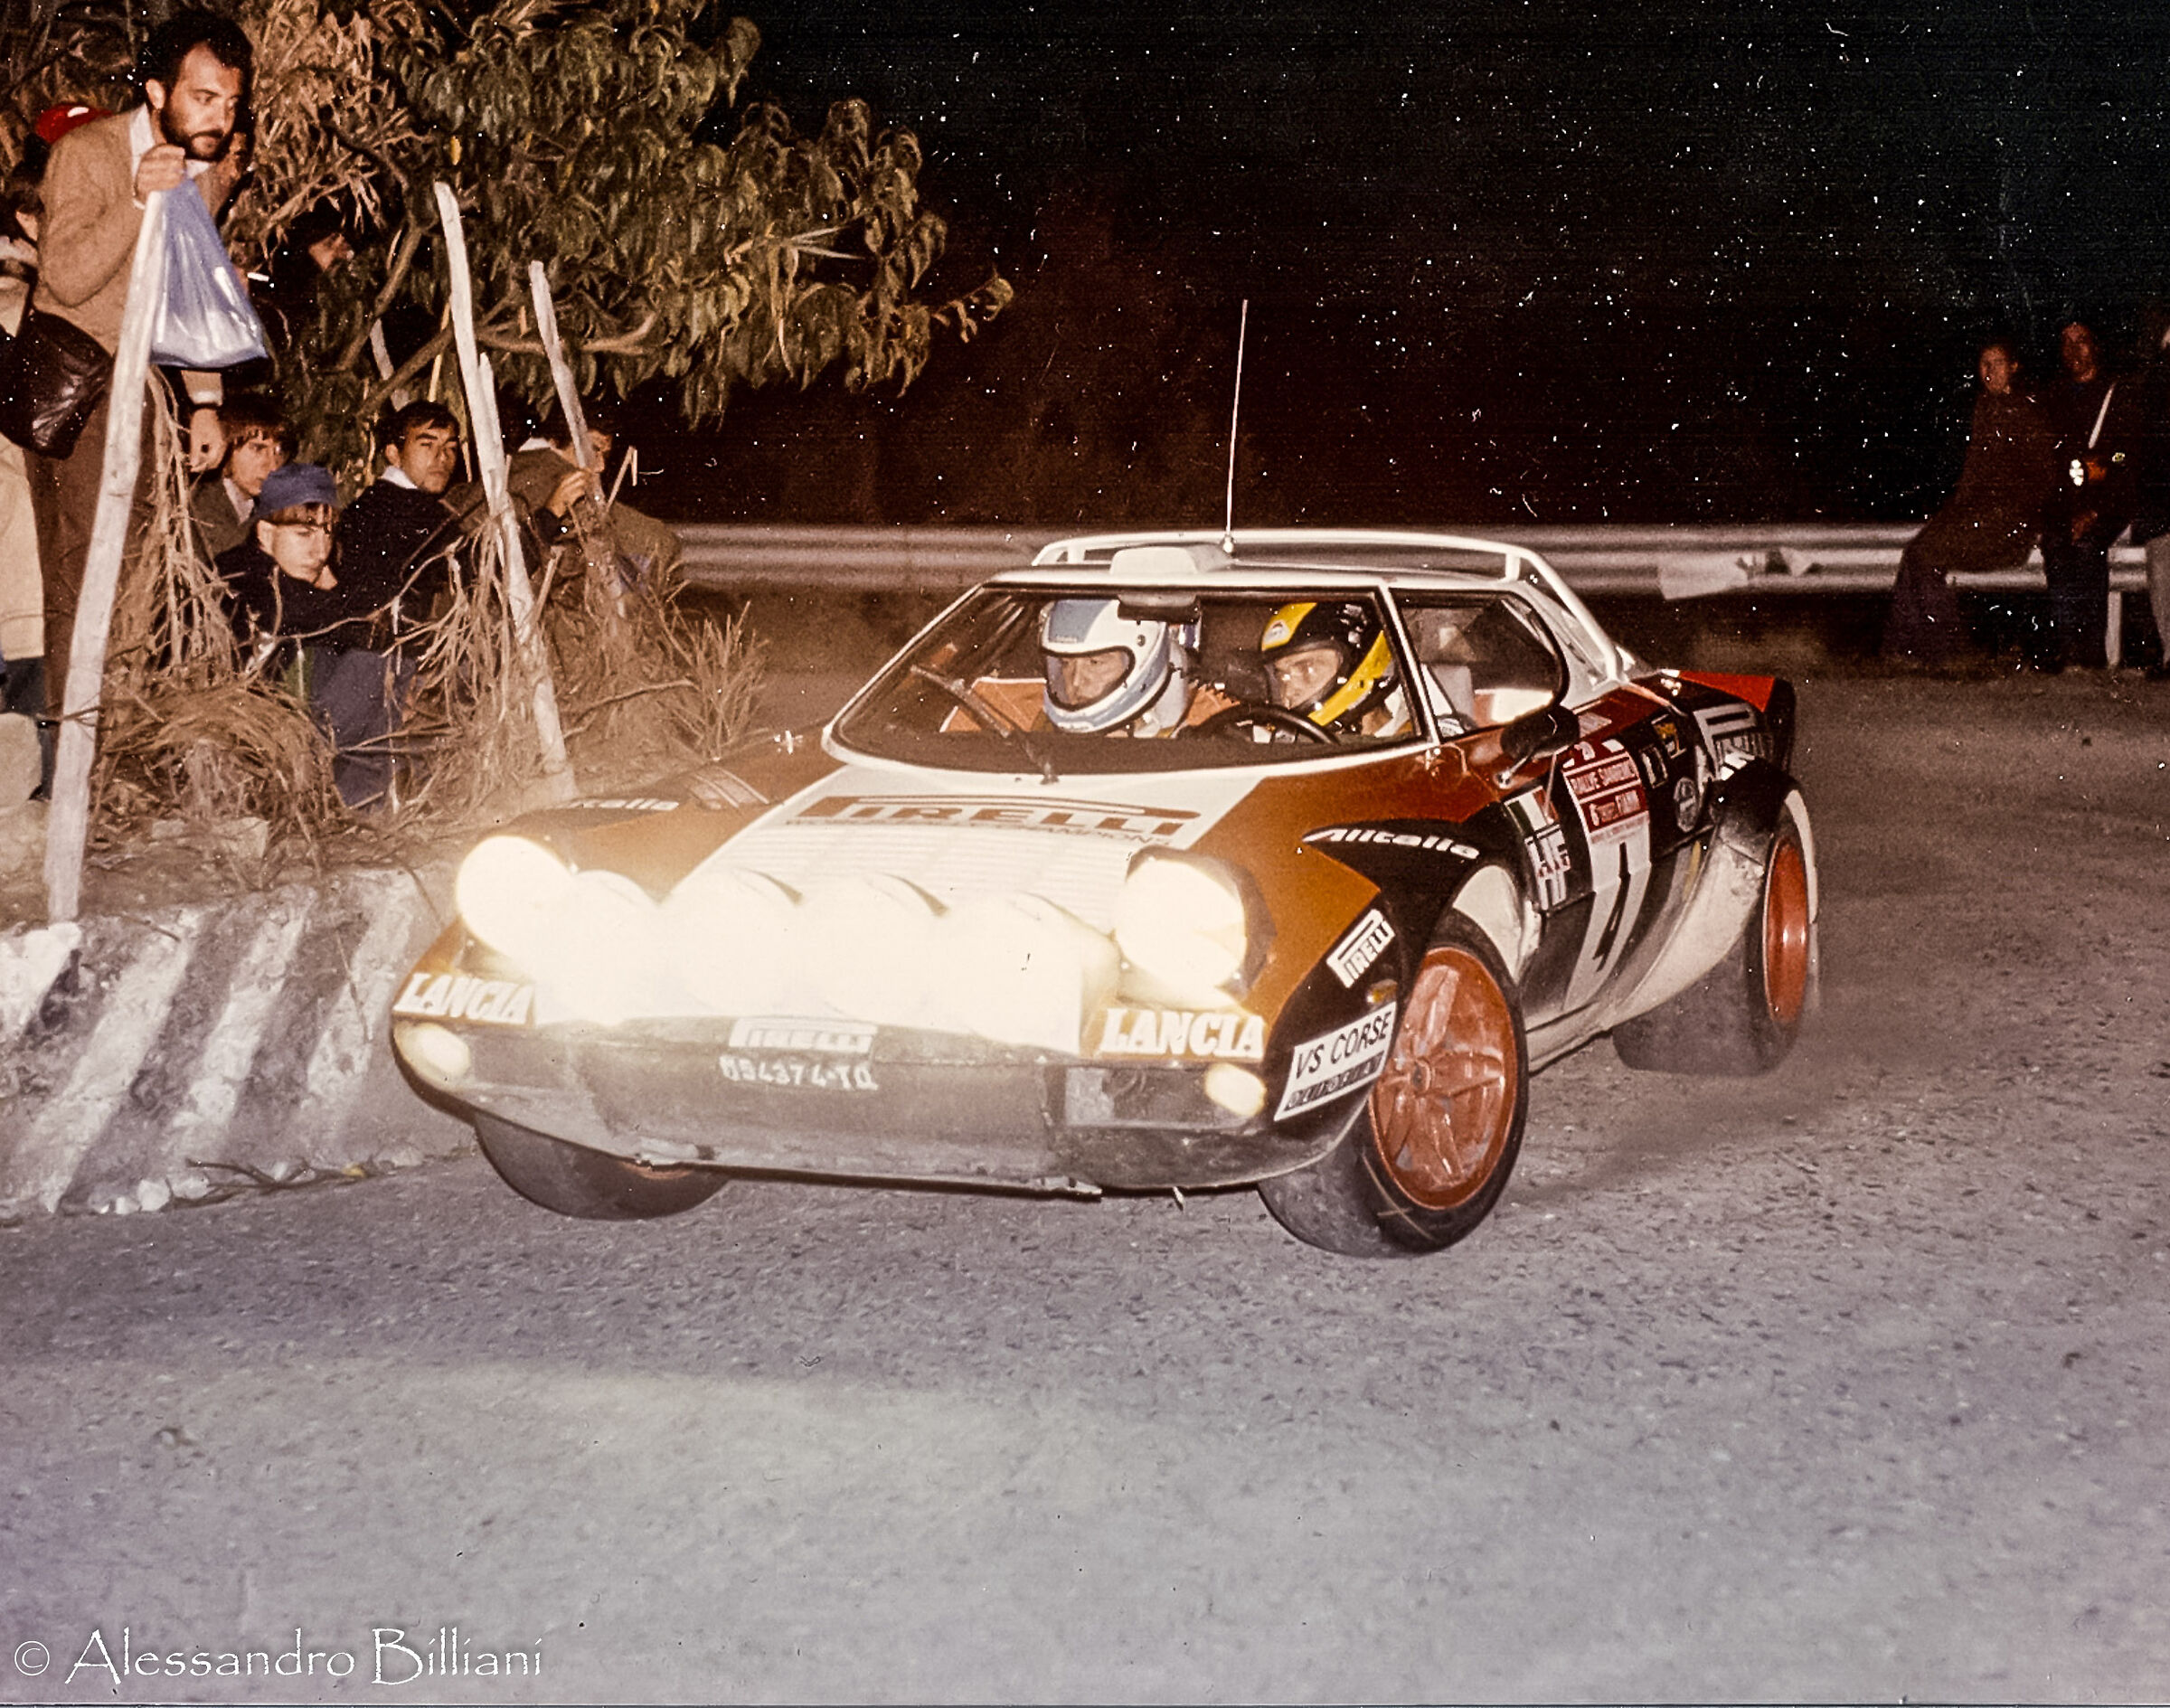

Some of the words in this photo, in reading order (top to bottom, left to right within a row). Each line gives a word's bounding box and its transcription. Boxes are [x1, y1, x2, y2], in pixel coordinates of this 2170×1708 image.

[795, 795, 1201, 836] PIRELLI
[1302, 828, 1480, 859] Alitalia
[1326, 909, 1396, 988] PIRELLI
[392, 972, 534, 1024] LANCIA
[729, 1015, 878, 1054] PIRELLI
[1099, 1007, 1266, 1059] LANCIA
[1296, 1043, 1324, 1080] VS
[1330, 1011, 1392, 1064] CORSE
